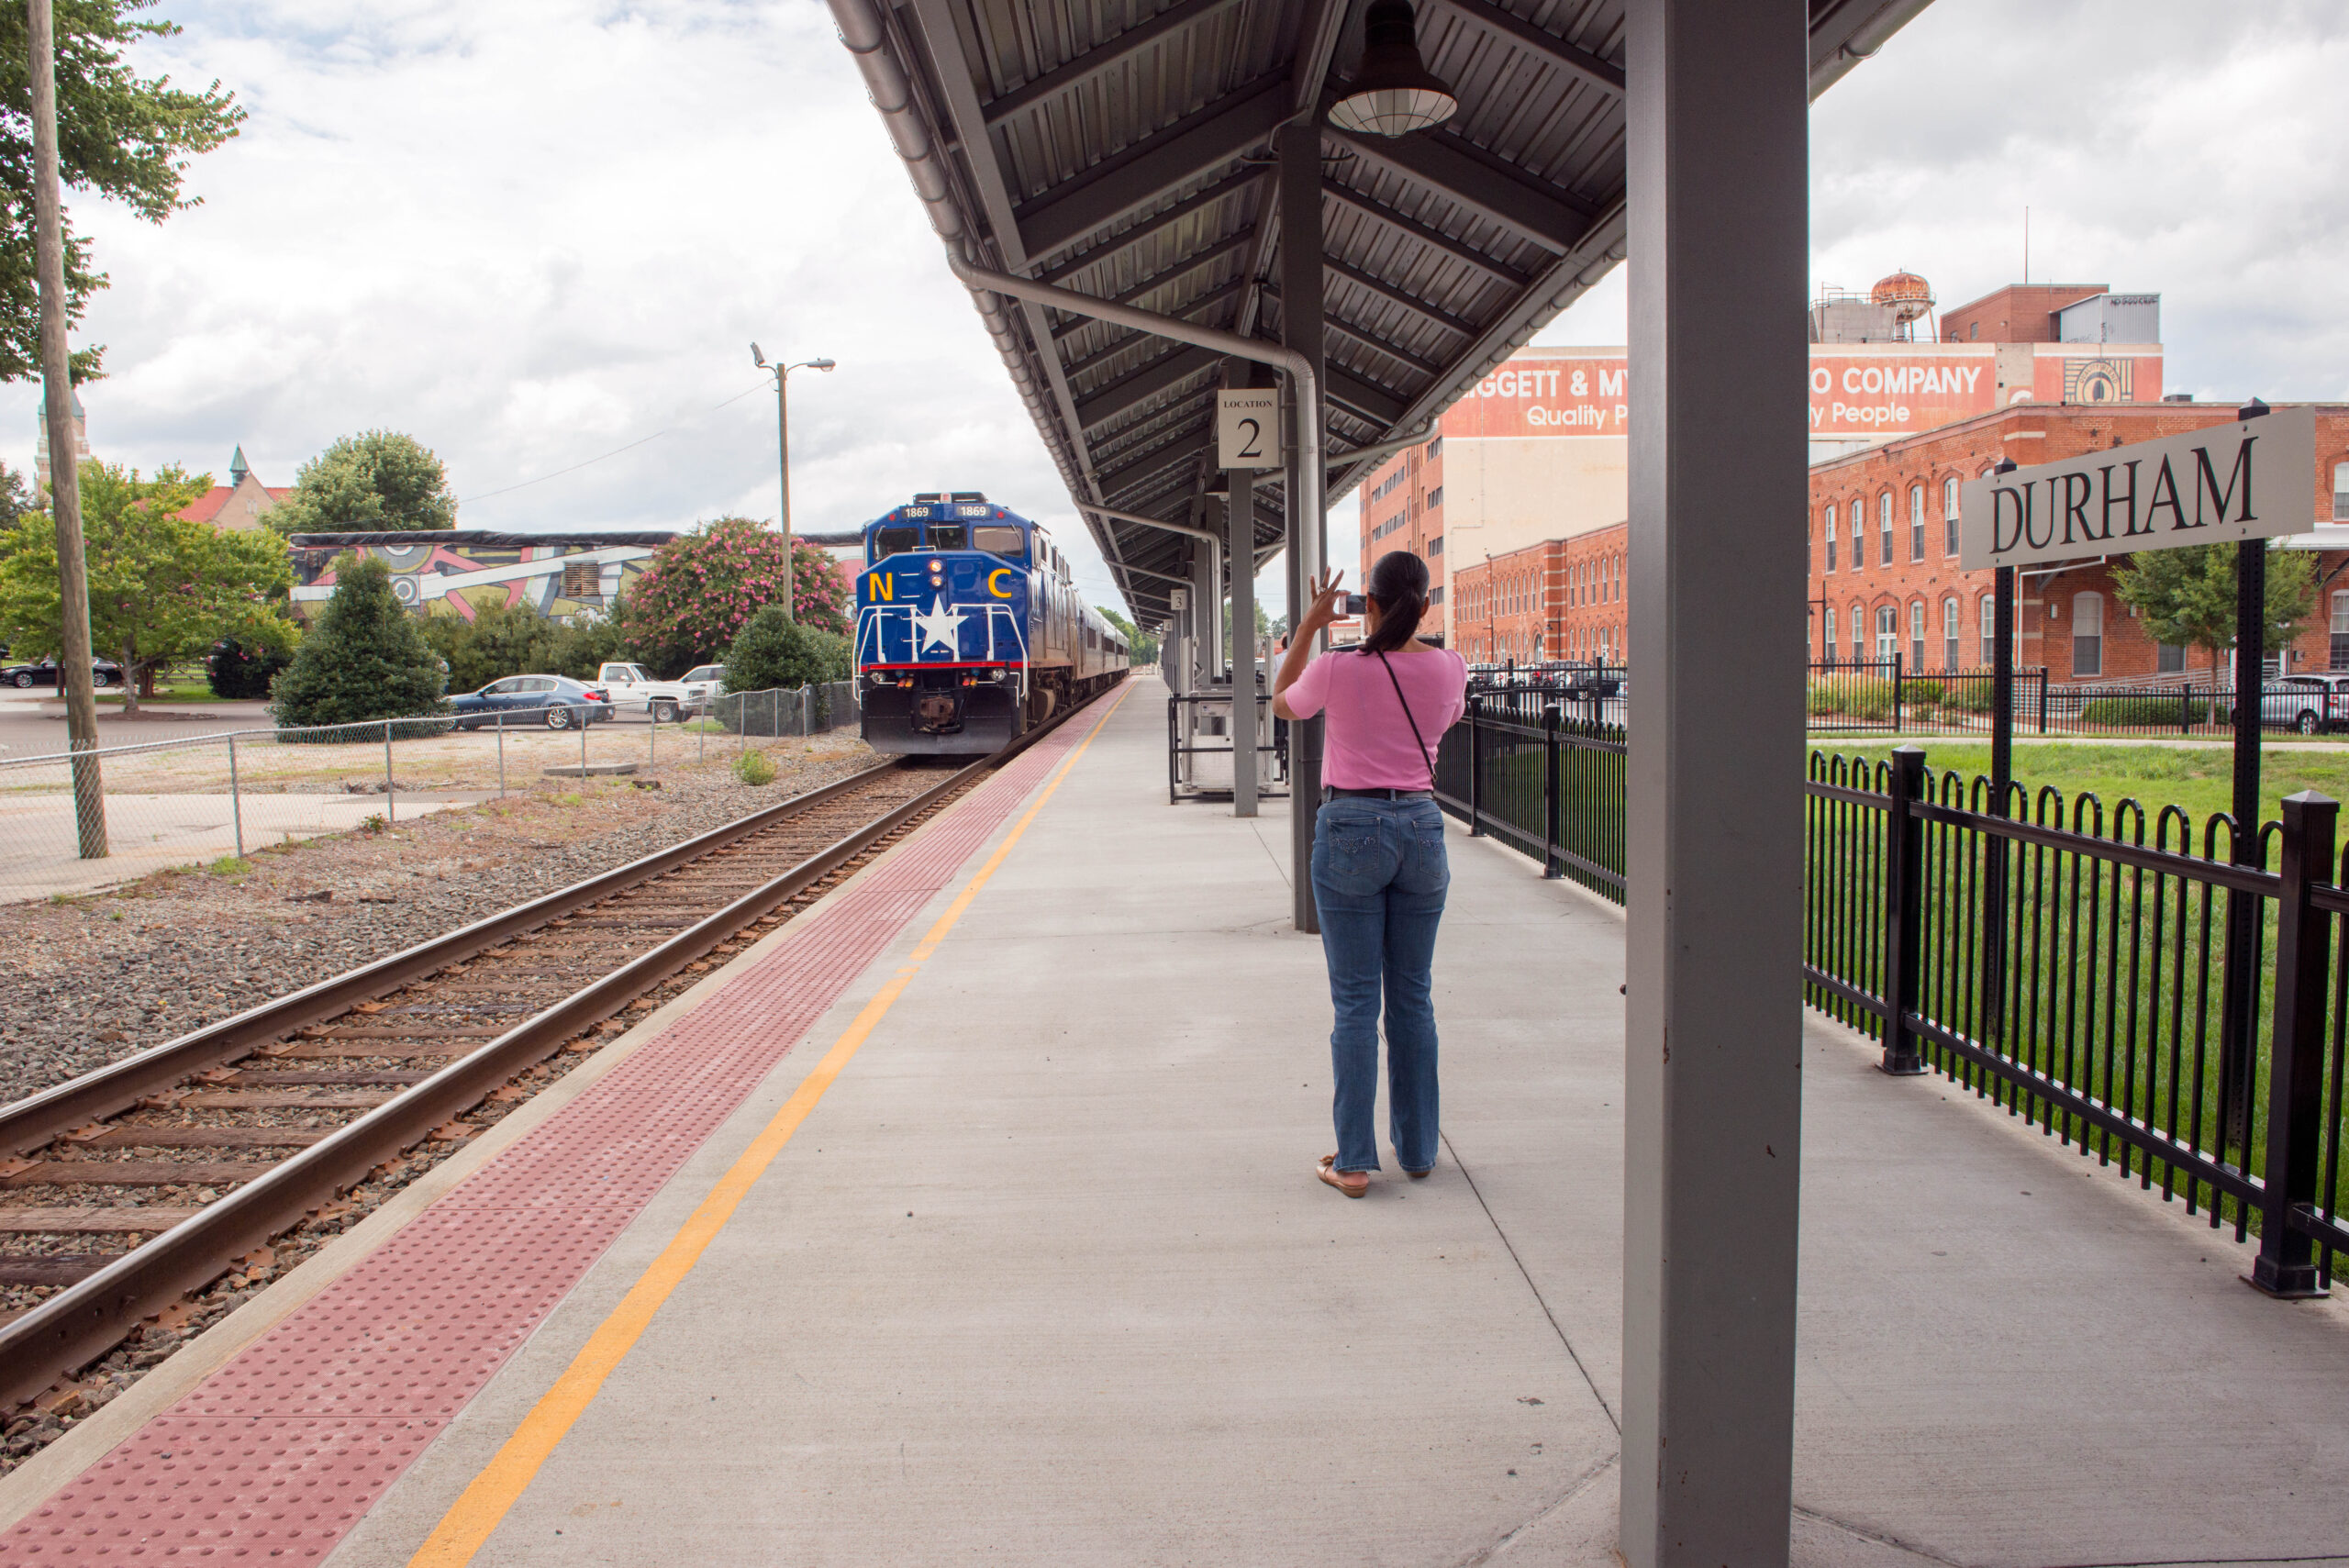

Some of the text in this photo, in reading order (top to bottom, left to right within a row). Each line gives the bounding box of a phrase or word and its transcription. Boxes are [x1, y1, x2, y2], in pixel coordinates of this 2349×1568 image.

[1463, 367, 1982, 398] GGETT & M O COMPANY
[1223, 400, 1273, 408] LOCATION
[1527, 405, 1606, 430] Quality
[1832, 402, 1910, 427] People
[1237, 417, 1263, 458] 2
[1989, 436, 2259, 554] DURHAM
[905, 506, 929, 518] 1869
[961, 506, 986, 517] 1869
[869, 568, 1012, 601] N C
[1175, 596, 1182, 607] 3
